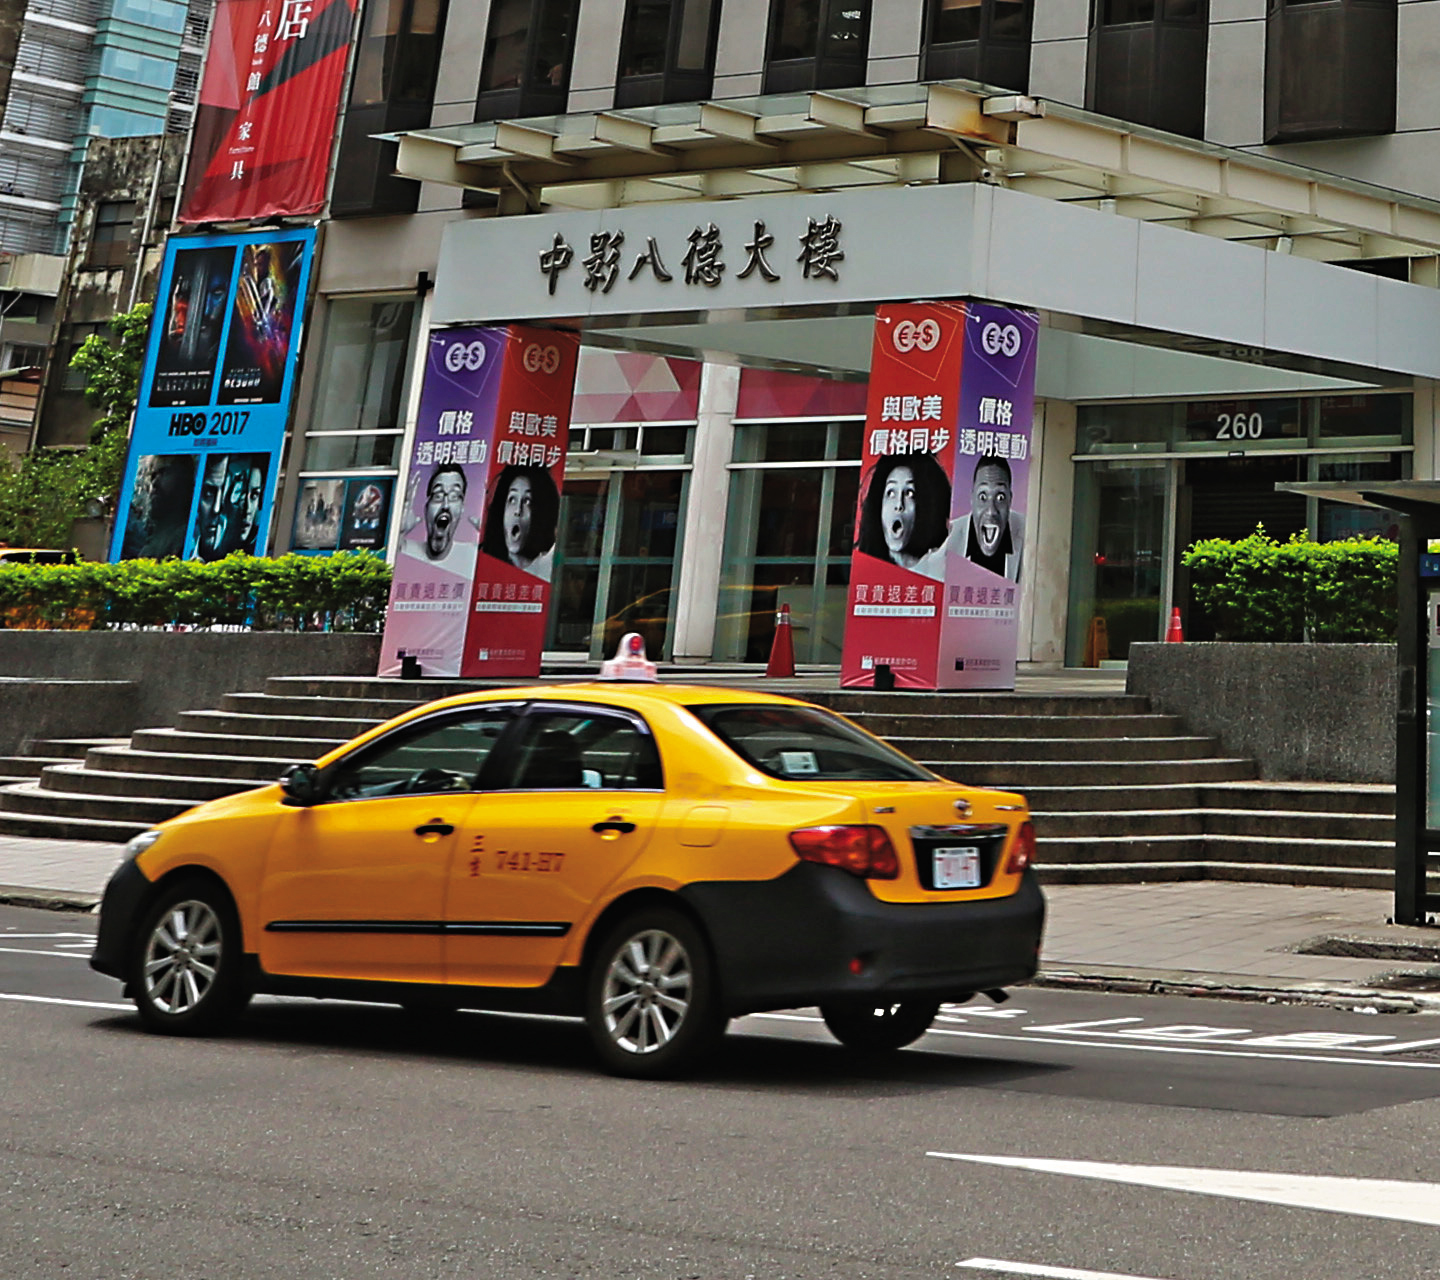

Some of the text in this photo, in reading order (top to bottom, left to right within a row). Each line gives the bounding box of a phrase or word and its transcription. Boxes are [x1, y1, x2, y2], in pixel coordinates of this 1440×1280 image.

[539, 214, 845, 295] 中影八德大樓
[881, 394, 943, 422] 與歐美
[979, 397, 1013, 426] 價格
[168, 411, 250, 436] HBO 2017
[438, 410, 473, 436] 價格
[1216, 412, 1262, 439] 260
